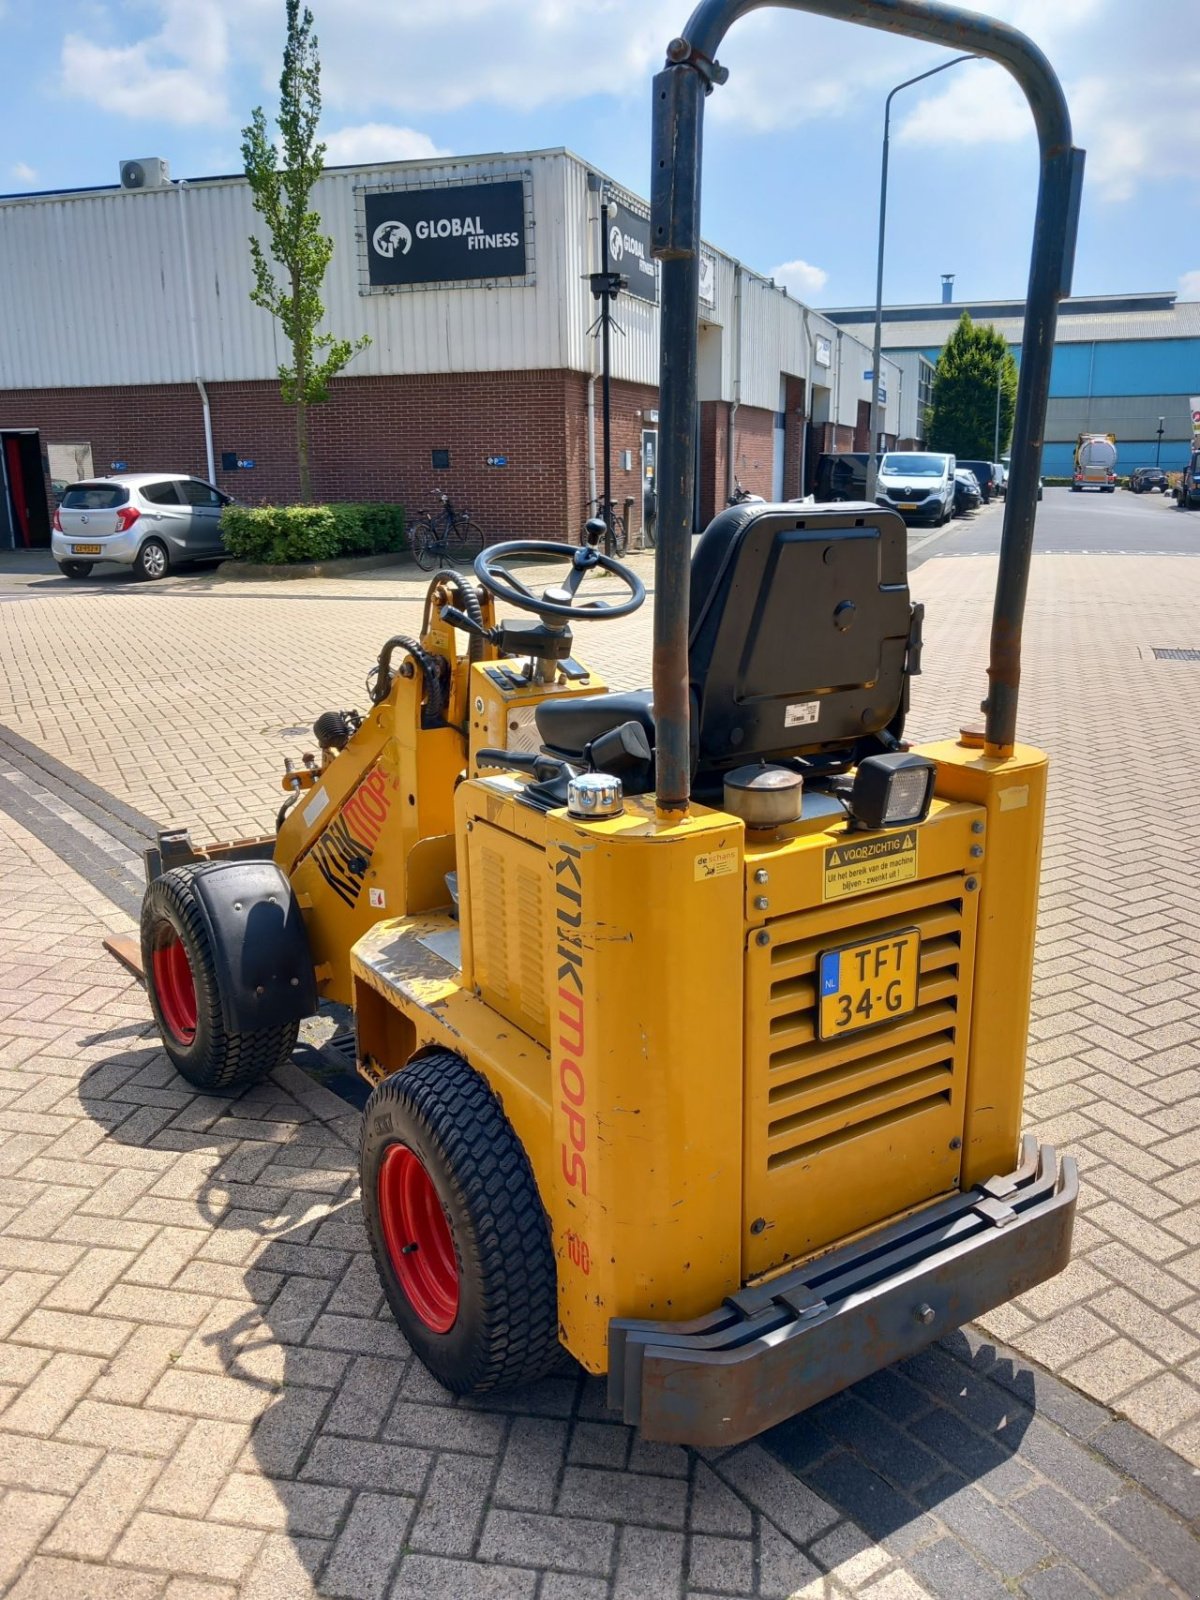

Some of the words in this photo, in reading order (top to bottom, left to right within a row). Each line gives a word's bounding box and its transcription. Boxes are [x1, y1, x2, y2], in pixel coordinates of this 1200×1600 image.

[415, 216, 484, 239] GLOBAL
[468, 232, 519, 250] FITNESS
[623, 233, 645, 260] GLOBAL
[843, 839, 900, 861] VOORZICHTIG
[827, 873, 837, 883] Uit
[838, 871, 848, 880] het
[849, 866, 867, 878] bereik
[868, 864, 880, 873] van
[881, 861, 889, 870] de
[889, 856, 914, 868] machine
[842, 879, 862, 891] blijven
[867, 872, 887, 884] zwenkt
[855, 939, 908, 982] TFT
[825, 978, 836, 989] NL
[835, 980, 902, 1026] 34-G
